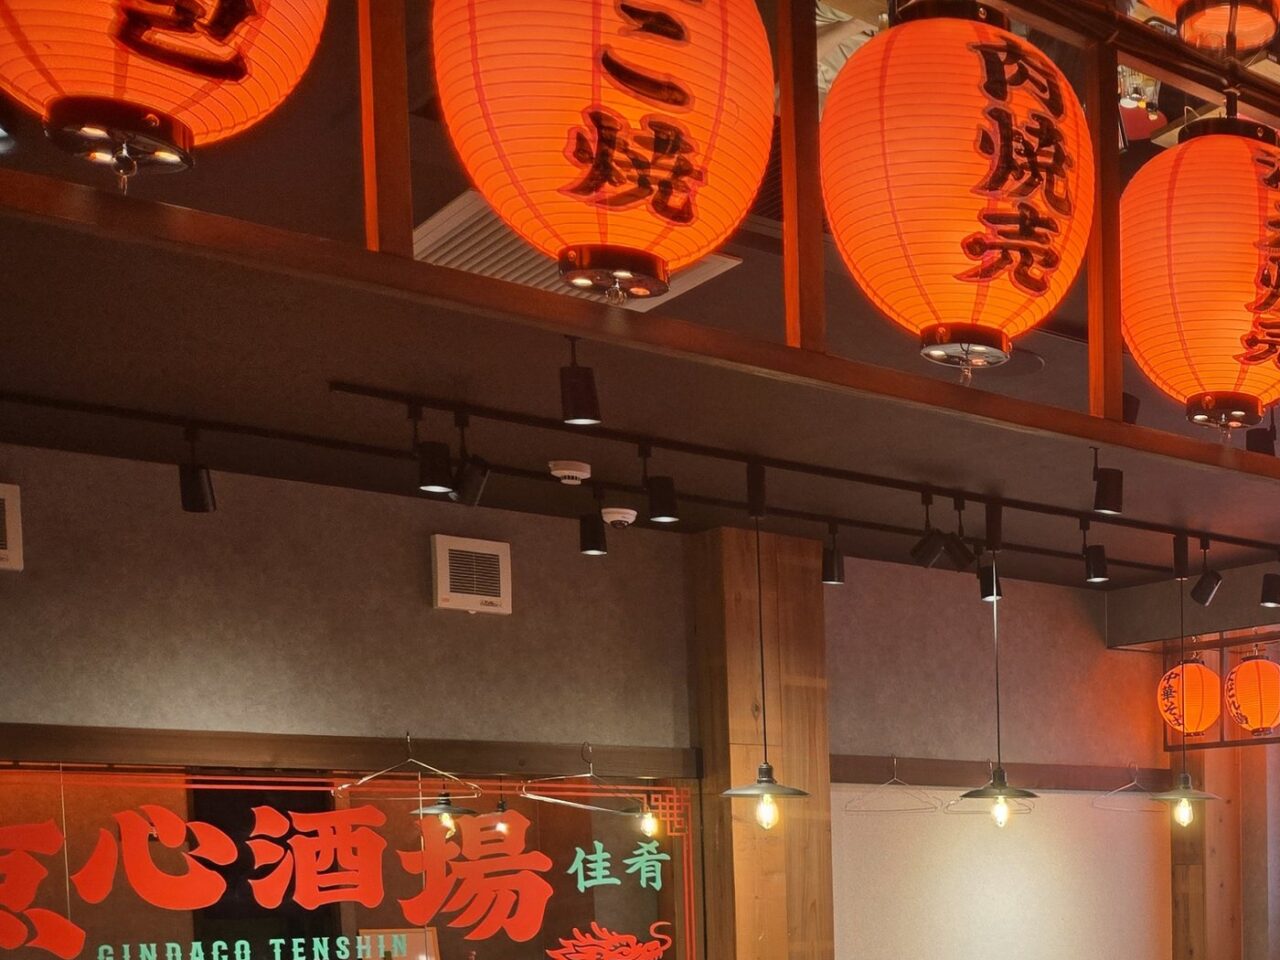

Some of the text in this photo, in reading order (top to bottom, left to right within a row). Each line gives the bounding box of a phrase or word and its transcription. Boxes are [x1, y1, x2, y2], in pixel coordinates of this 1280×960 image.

[958, 40, 1074, 293] 肉焼売
[1161, 671, 1184, 727] 中華そば
[567, 840, 671, 893] 佳肴
